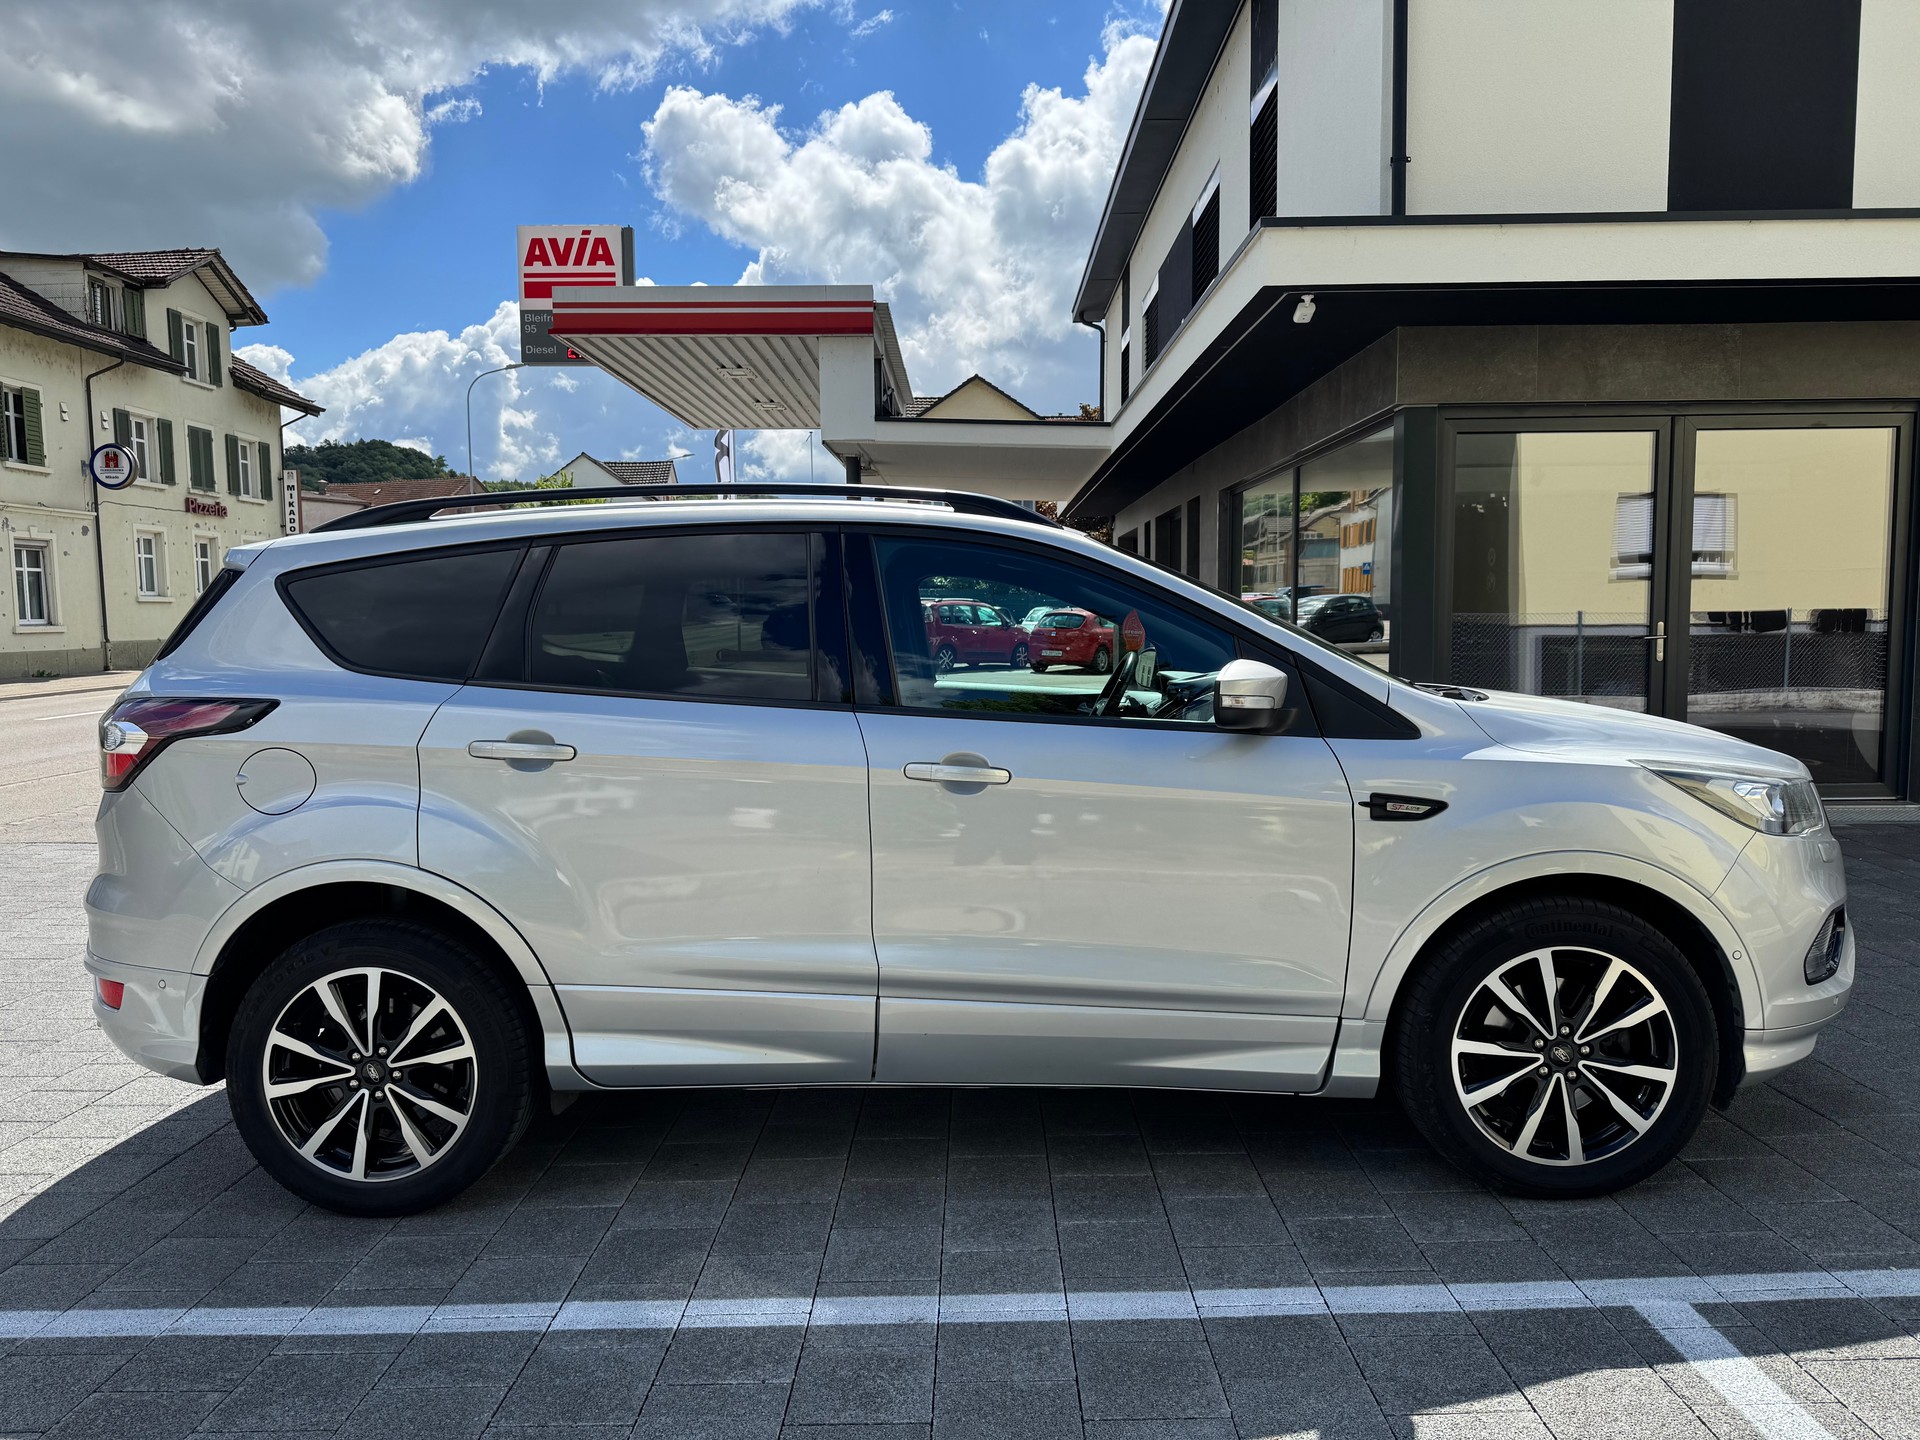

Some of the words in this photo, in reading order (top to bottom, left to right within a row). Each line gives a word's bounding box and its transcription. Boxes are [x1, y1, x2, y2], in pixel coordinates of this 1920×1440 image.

[524, 230, 615, 266] AVIA
[524, 324, 537, 333] 95
[525, 345, 557, 354] Diesel
[188, 498, 228, 517] Pizzeria
[286, 484, 296, 532] MIKADO
